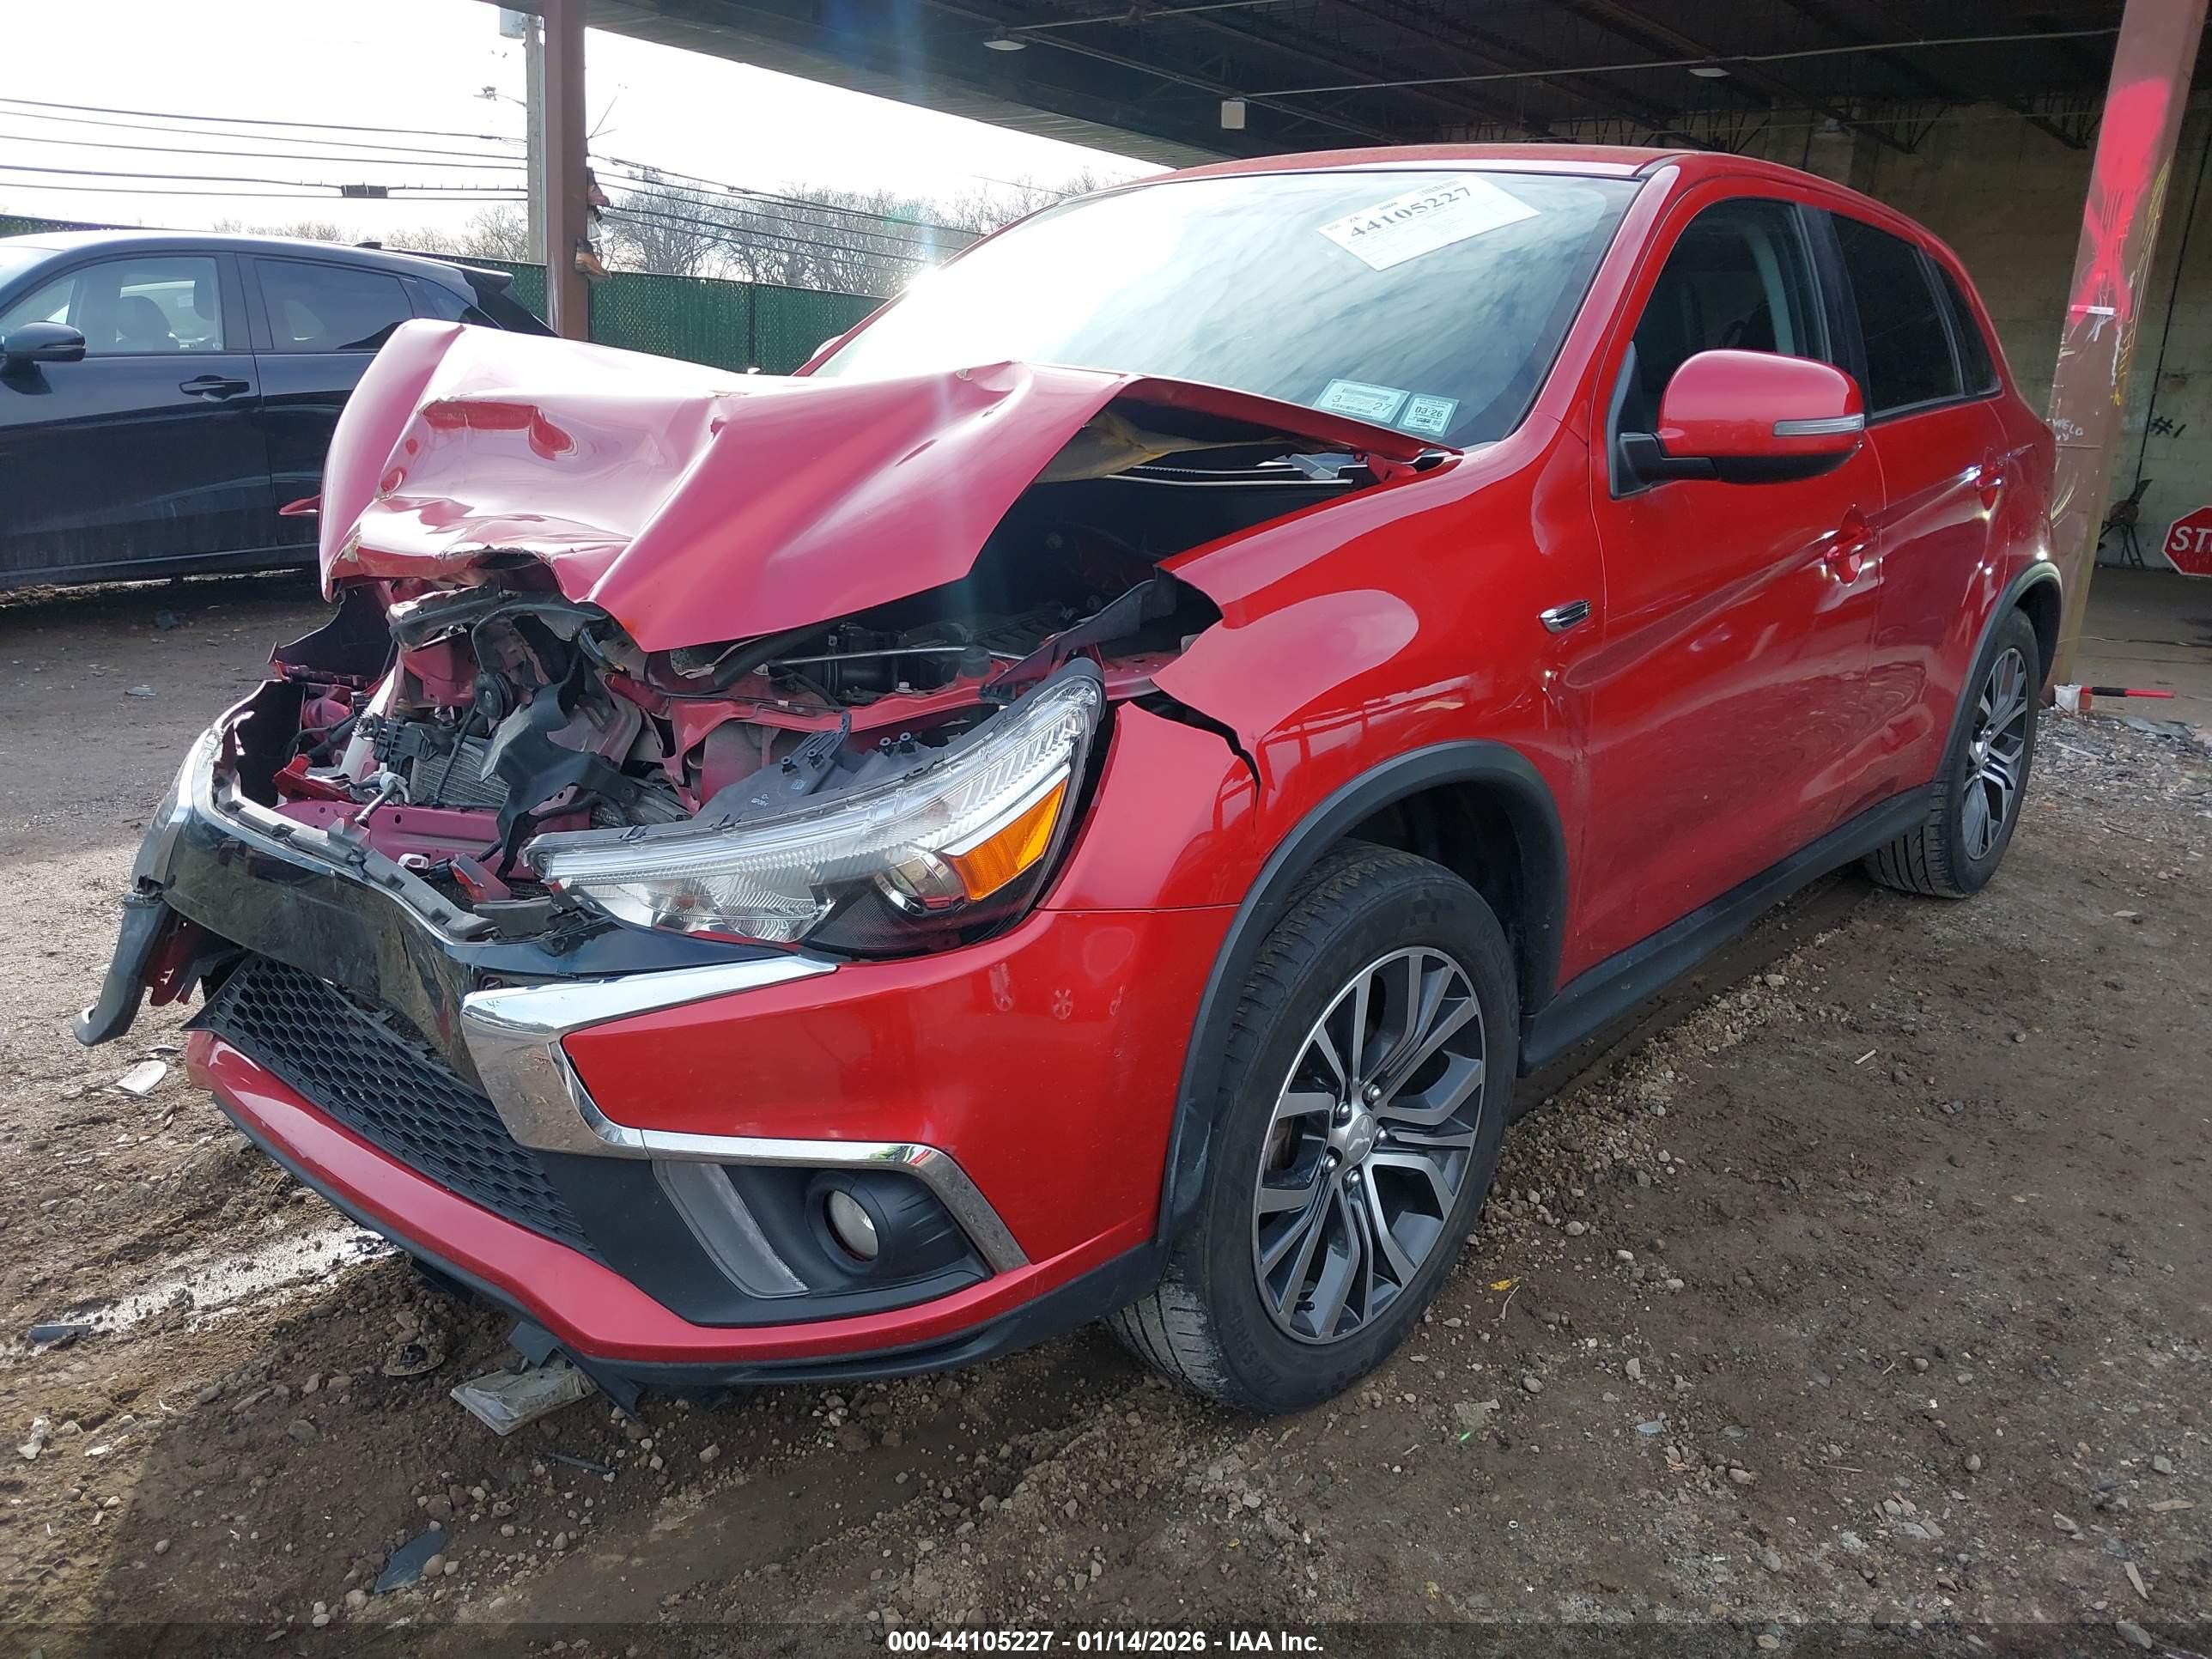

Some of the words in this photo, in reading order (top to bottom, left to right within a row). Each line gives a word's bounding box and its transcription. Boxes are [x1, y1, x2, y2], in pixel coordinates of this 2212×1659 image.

[1351, 186, 1472, 237] 44105227
[1332, 394, 1342, 403] 3
[1372, 401, 1394, 411] 27
[2170, 526, 2212, 553] ST
